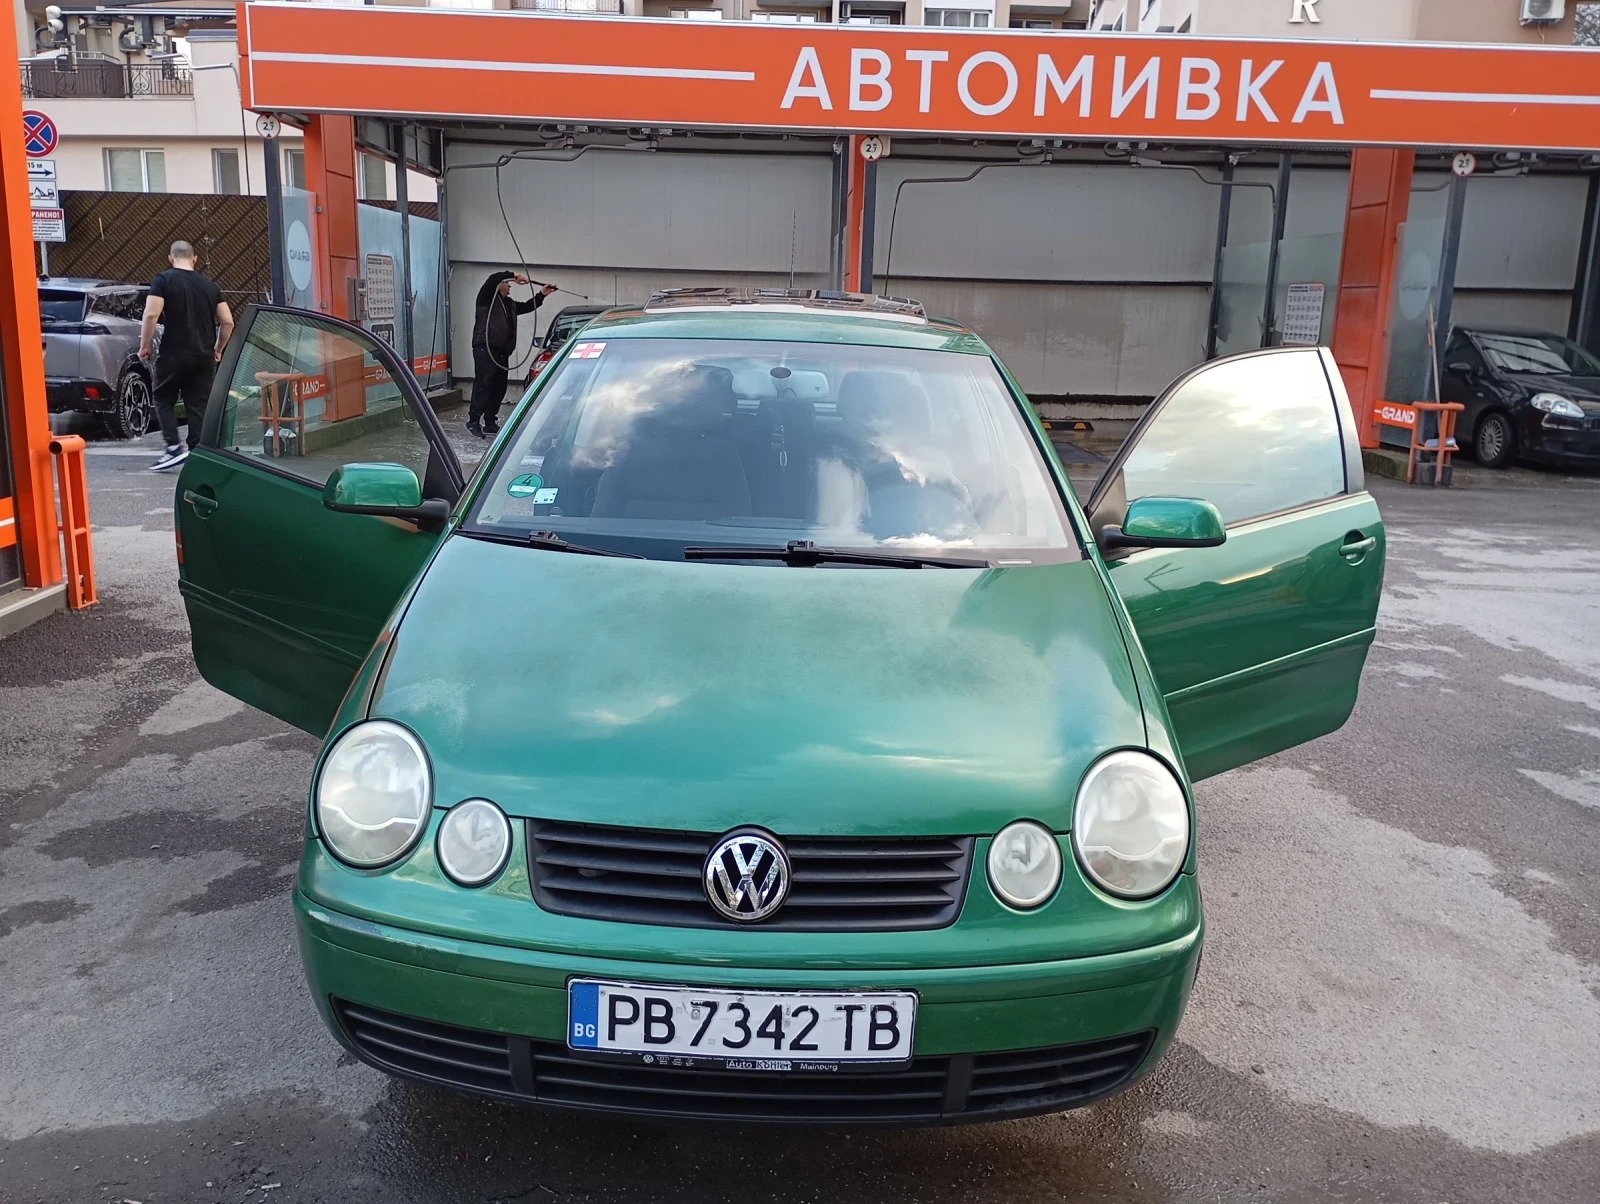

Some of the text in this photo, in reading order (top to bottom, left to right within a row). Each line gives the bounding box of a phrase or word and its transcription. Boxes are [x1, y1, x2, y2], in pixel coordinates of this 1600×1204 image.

[780, 46, 1345, 125] АВТОМИВКА
[31, 210, 60, 218] РАНЕНО!
[1381, 406, 1415, 424] GRAND
[574, 1022, 596, 1038] BG
[607, 994, 900, 1051] PB 7342 TB
[728, 1060, 753, 1069] Auto
